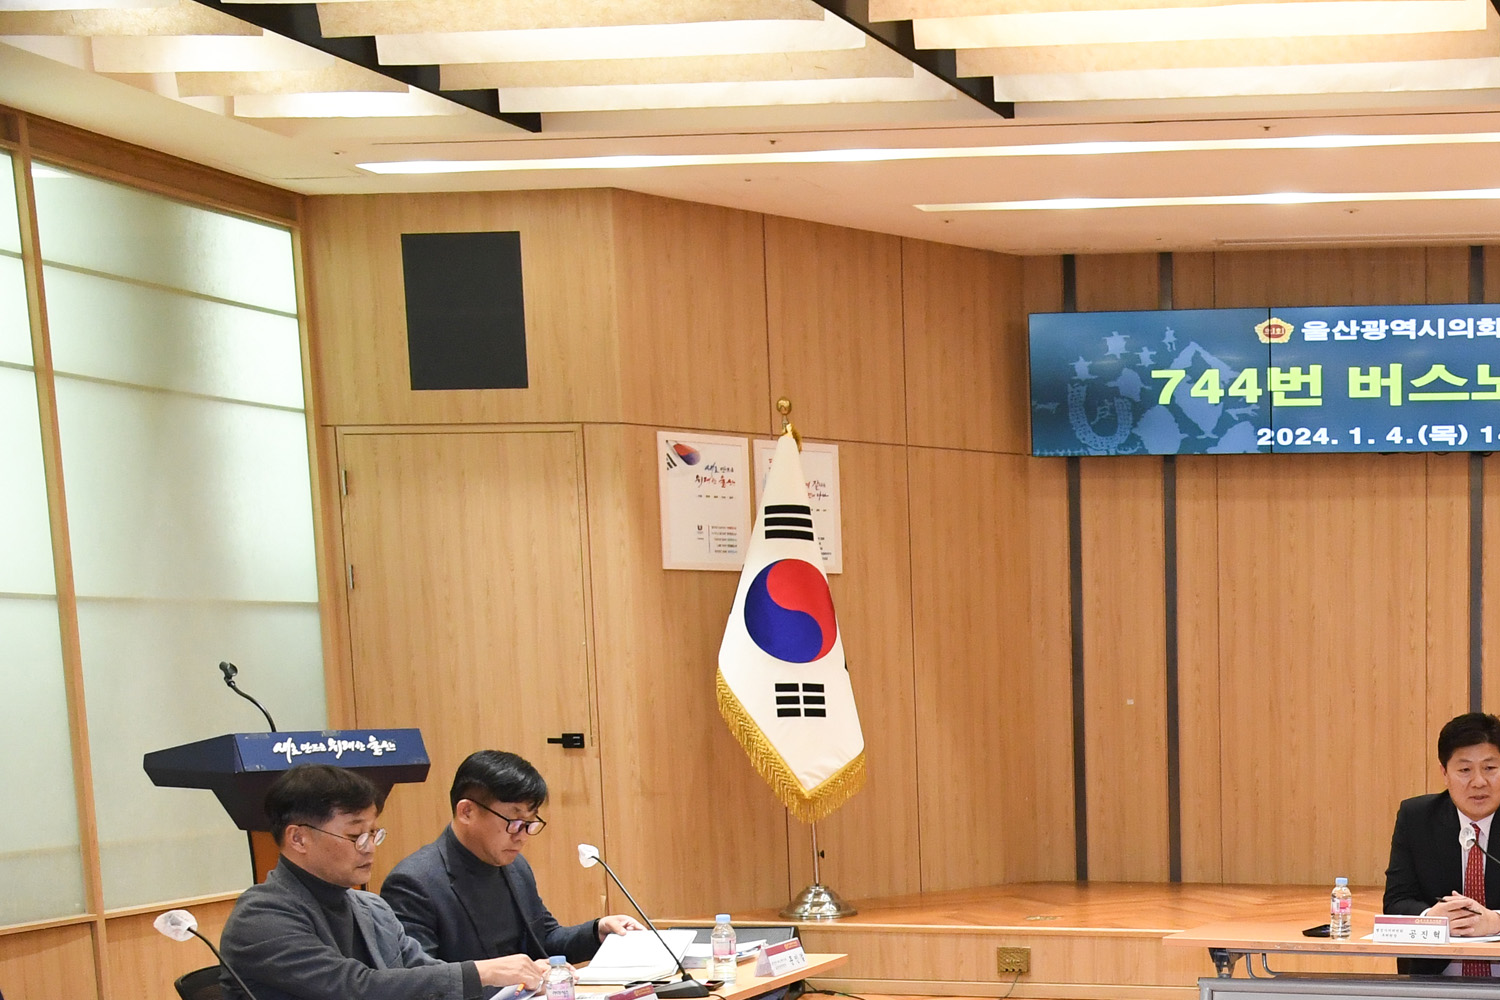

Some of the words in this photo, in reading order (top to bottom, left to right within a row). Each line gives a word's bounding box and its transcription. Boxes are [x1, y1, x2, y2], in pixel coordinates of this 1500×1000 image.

[1151, 363, 1323, 408] 744번
[1256, 427, 1339, 446] 2024.
[1347, 427, 1376, 446] 1.
[272, 736, 302, 764] 새로
[327, 737, 366, 759] 위대한
[366, 735, 397, 756] 울산
